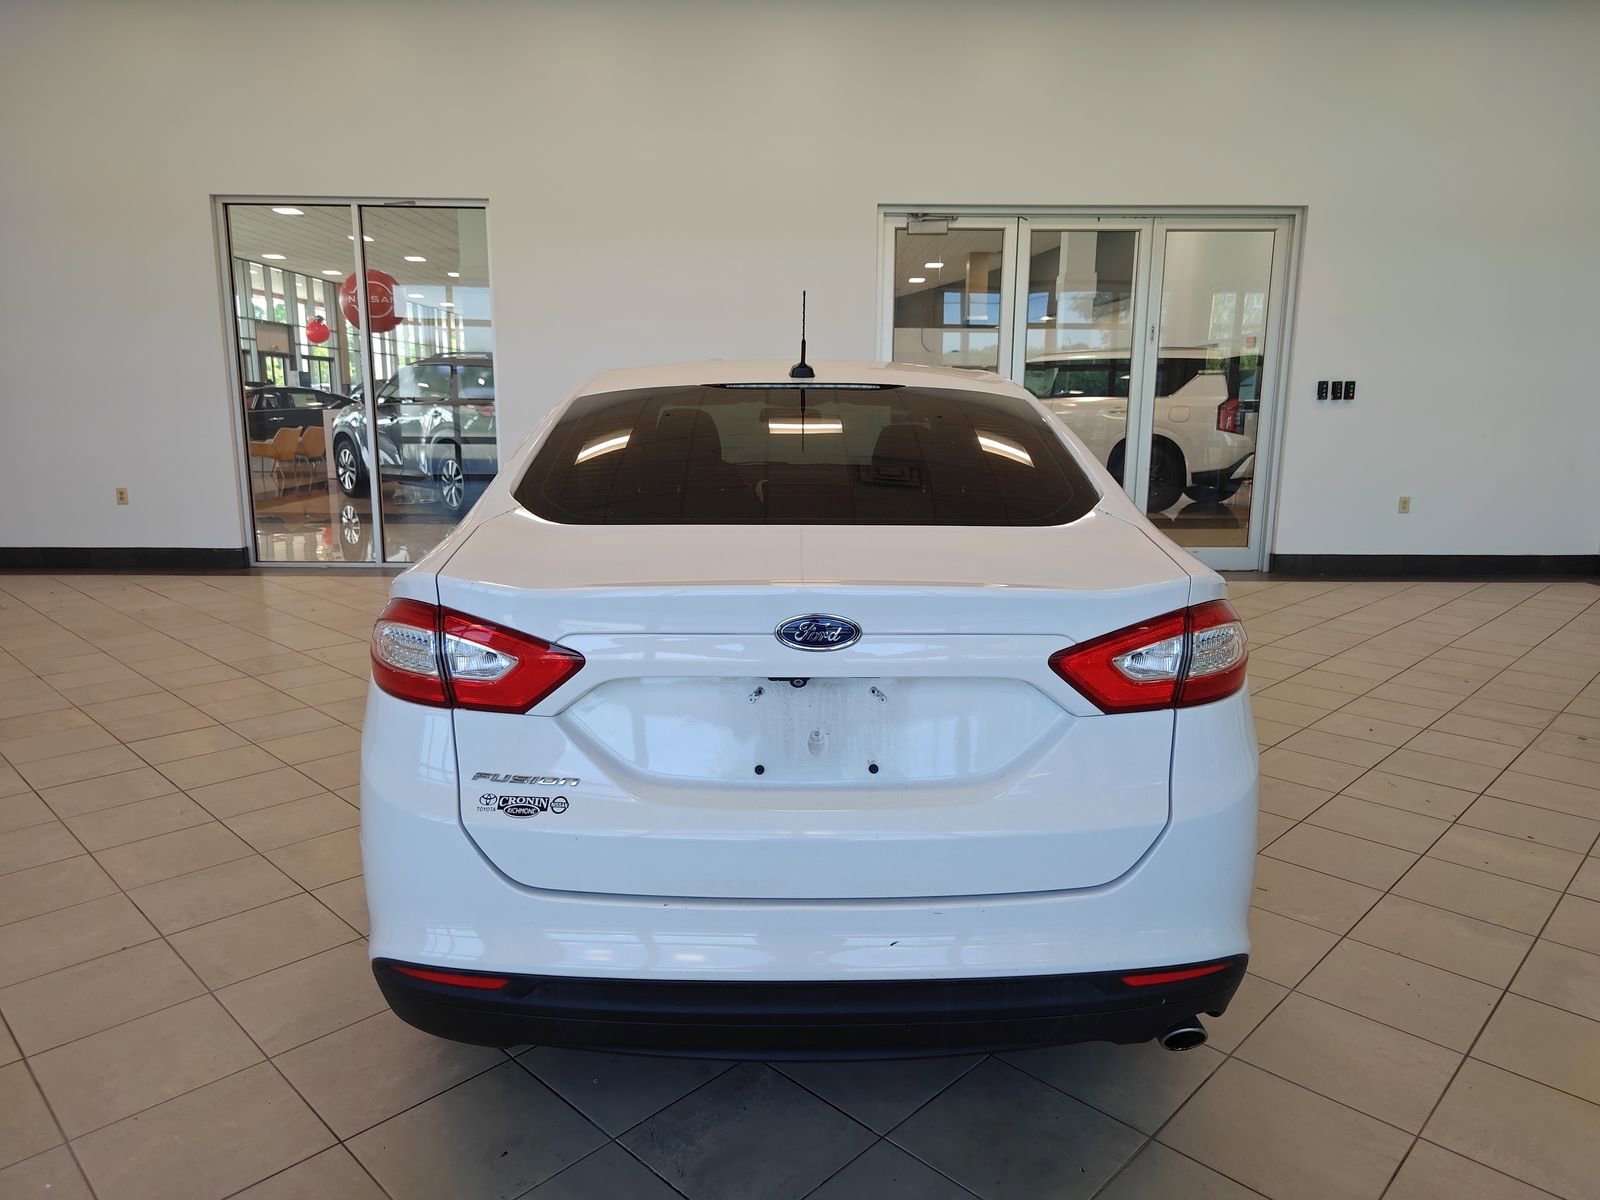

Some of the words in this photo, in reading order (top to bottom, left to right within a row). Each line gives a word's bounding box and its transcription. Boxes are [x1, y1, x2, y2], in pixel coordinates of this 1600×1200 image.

[795, 621, 842, 641] Ford
[472, 772, 580, 786] FUSION
[499, 796, 548, 809] CRONIN
[507, 807, 538, 815] RICHMOND
